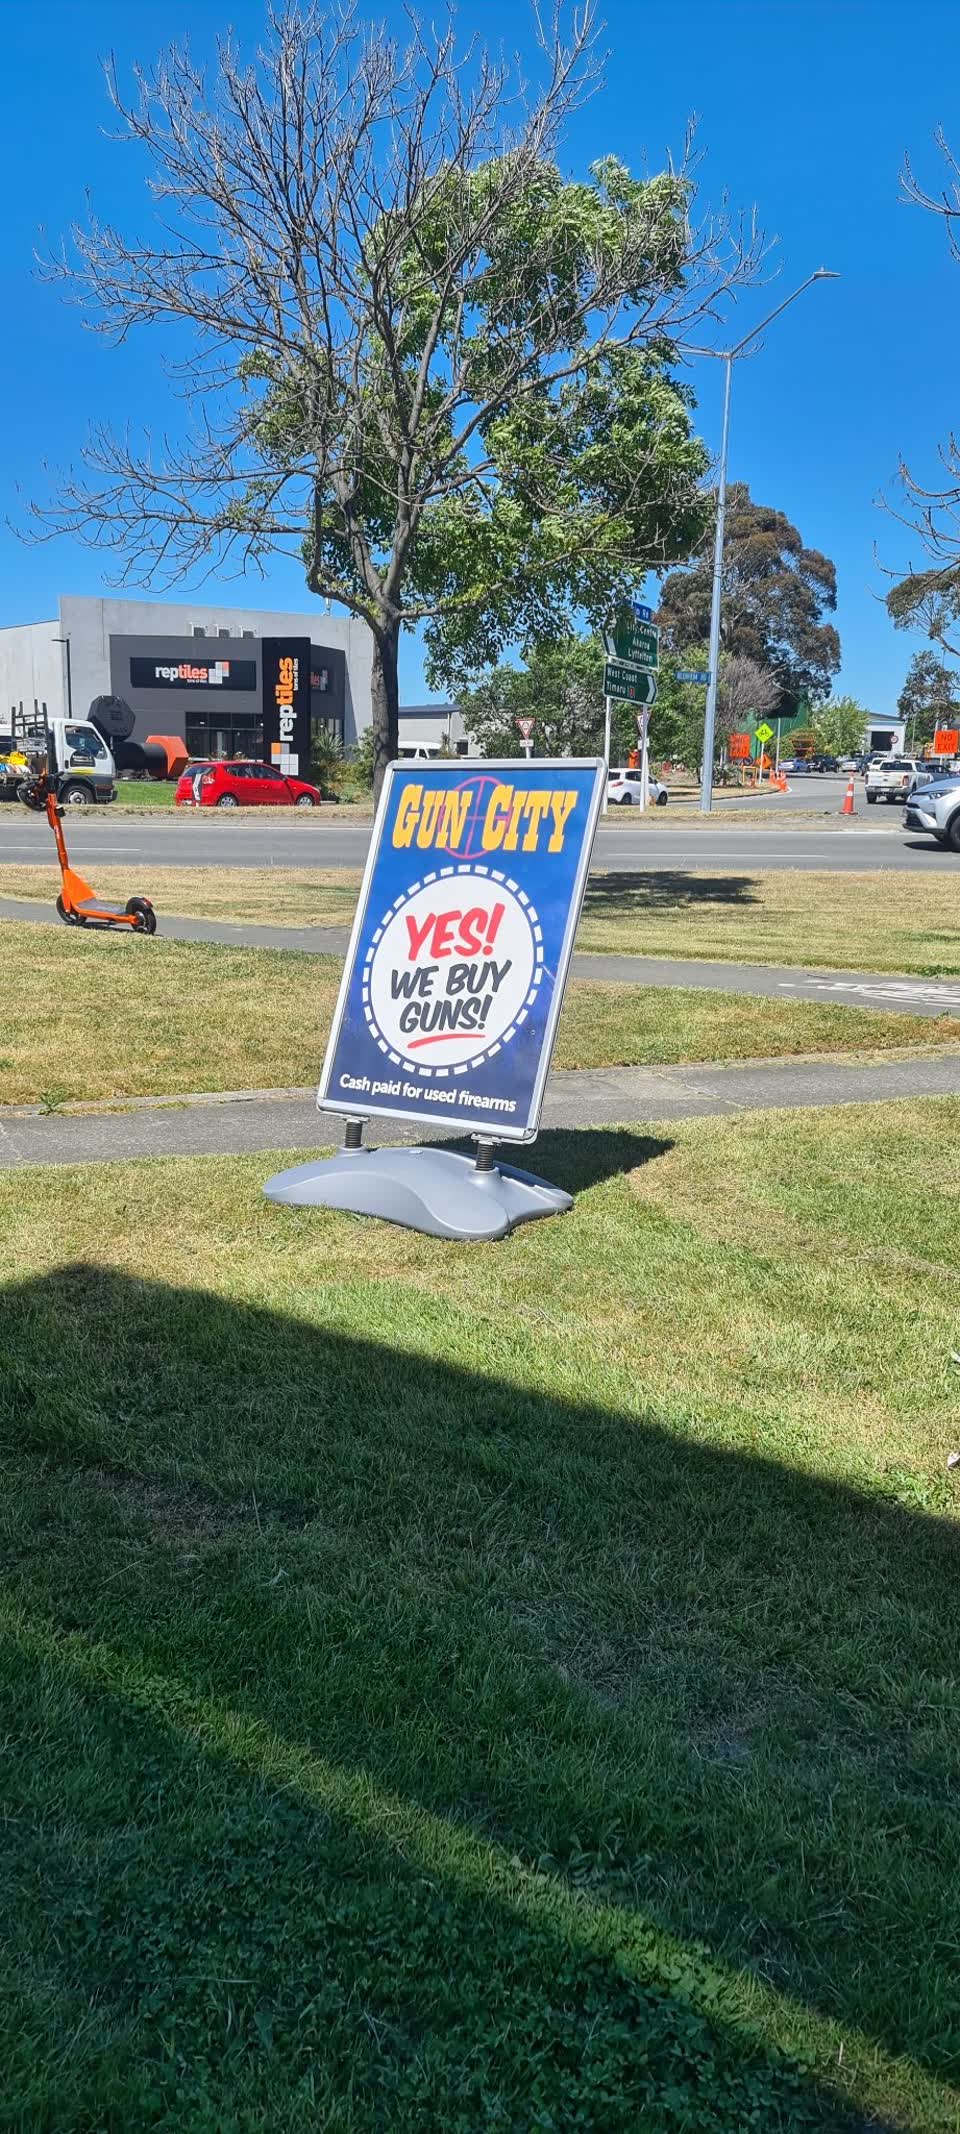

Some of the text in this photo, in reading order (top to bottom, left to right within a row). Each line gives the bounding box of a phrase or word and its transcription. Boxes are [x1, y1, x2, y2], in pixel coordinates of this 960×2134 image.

[155, 664, 208, 682] reptiles
[606, 681, 626, 694] Timaru
[607, 666, 638, 683] West Coast
[275, 657, 297, 741] reptiles
[937, 742, 956, 751] EXIT
[941, 733, 953, 741] NO
[392, 784, 579, 853] GUN CITY
[405, 902, 506, 961] YES!
[391, 959, 513, 1000] WE BUY
[399, 994, 494, 1034] GUNS!
[339, 1073, 517, 1113] Cash paid for used firearms
